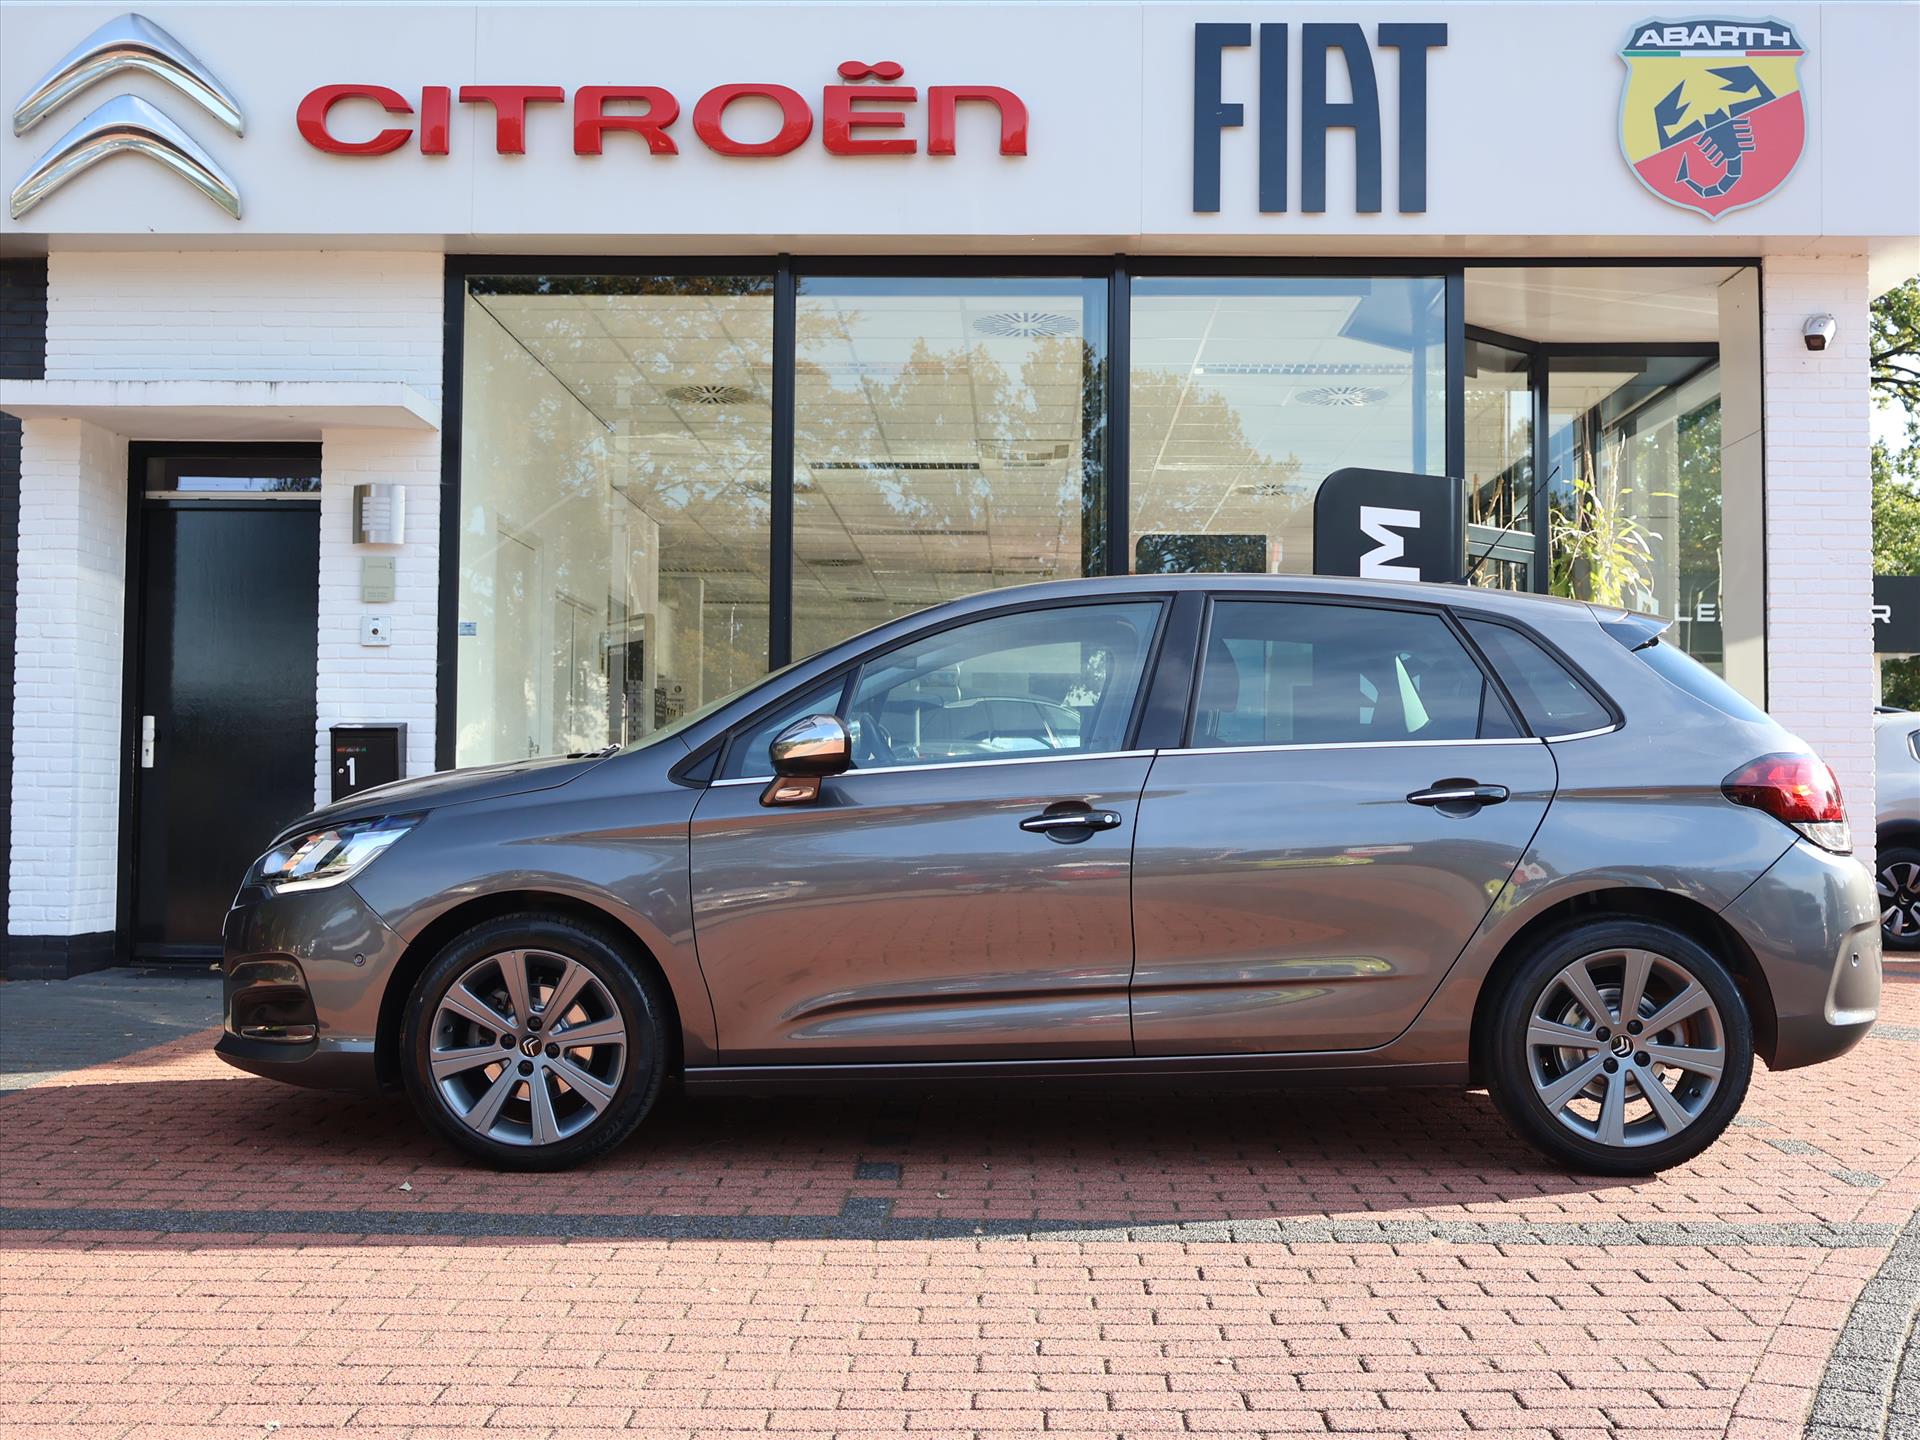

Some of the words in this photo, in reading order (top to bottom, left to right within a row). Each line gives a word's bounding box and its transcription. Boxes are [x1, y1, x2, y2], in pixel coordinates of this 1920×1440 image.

[1636, 25, 1790, 47] ABARTH
[1193, 22, 1448, 213] FIAT
[346, 757, 356, 787] 1
